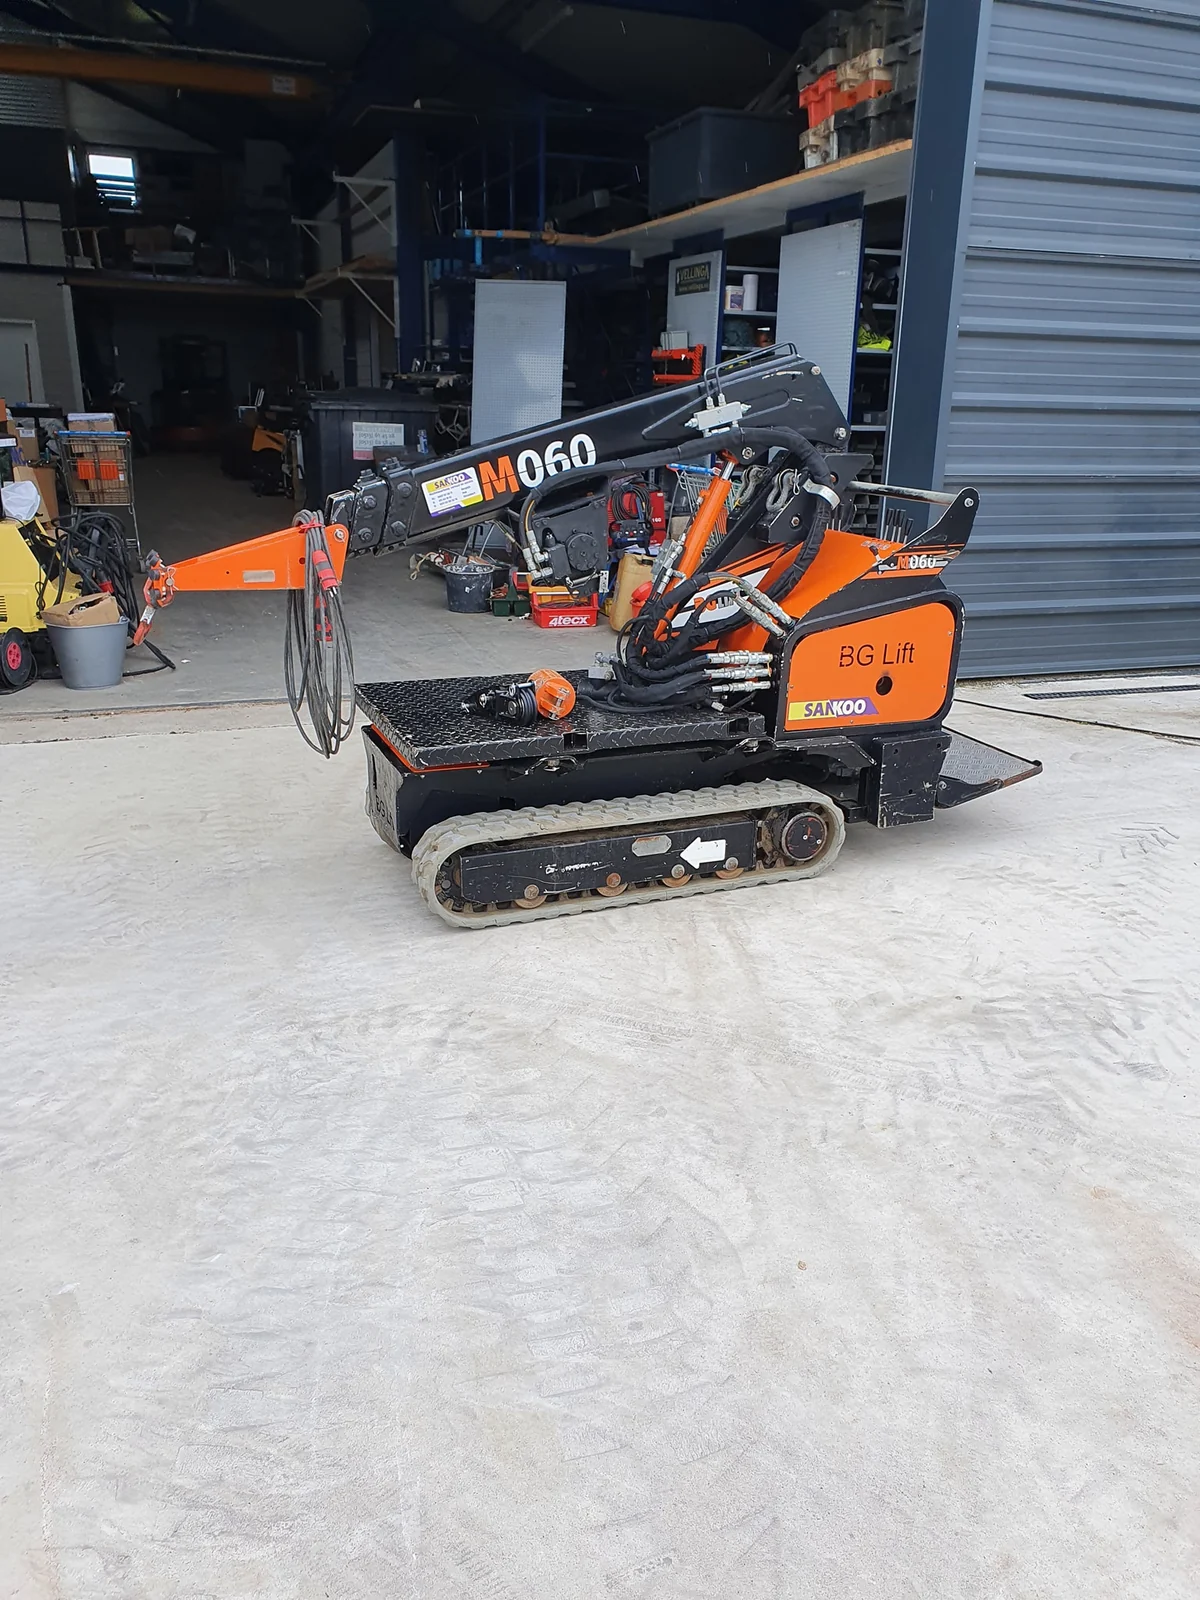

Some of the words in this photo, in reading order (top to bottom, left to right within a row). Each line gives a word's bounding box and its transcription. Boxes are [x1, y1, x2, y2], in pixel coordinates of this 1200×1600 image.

[679, 264, 710, 281] VELLINGA
[478, 434, 597, 501] M060
[434, 473, 466, 490] SANKOO
[897, 555, 936, 570] M060
[549, 615, 588, 627] 4tecx
[839, 644, 874, 668] BG
[882, 642, 915, 665] Lift
[804, 699, 867, 717] SANKOO
